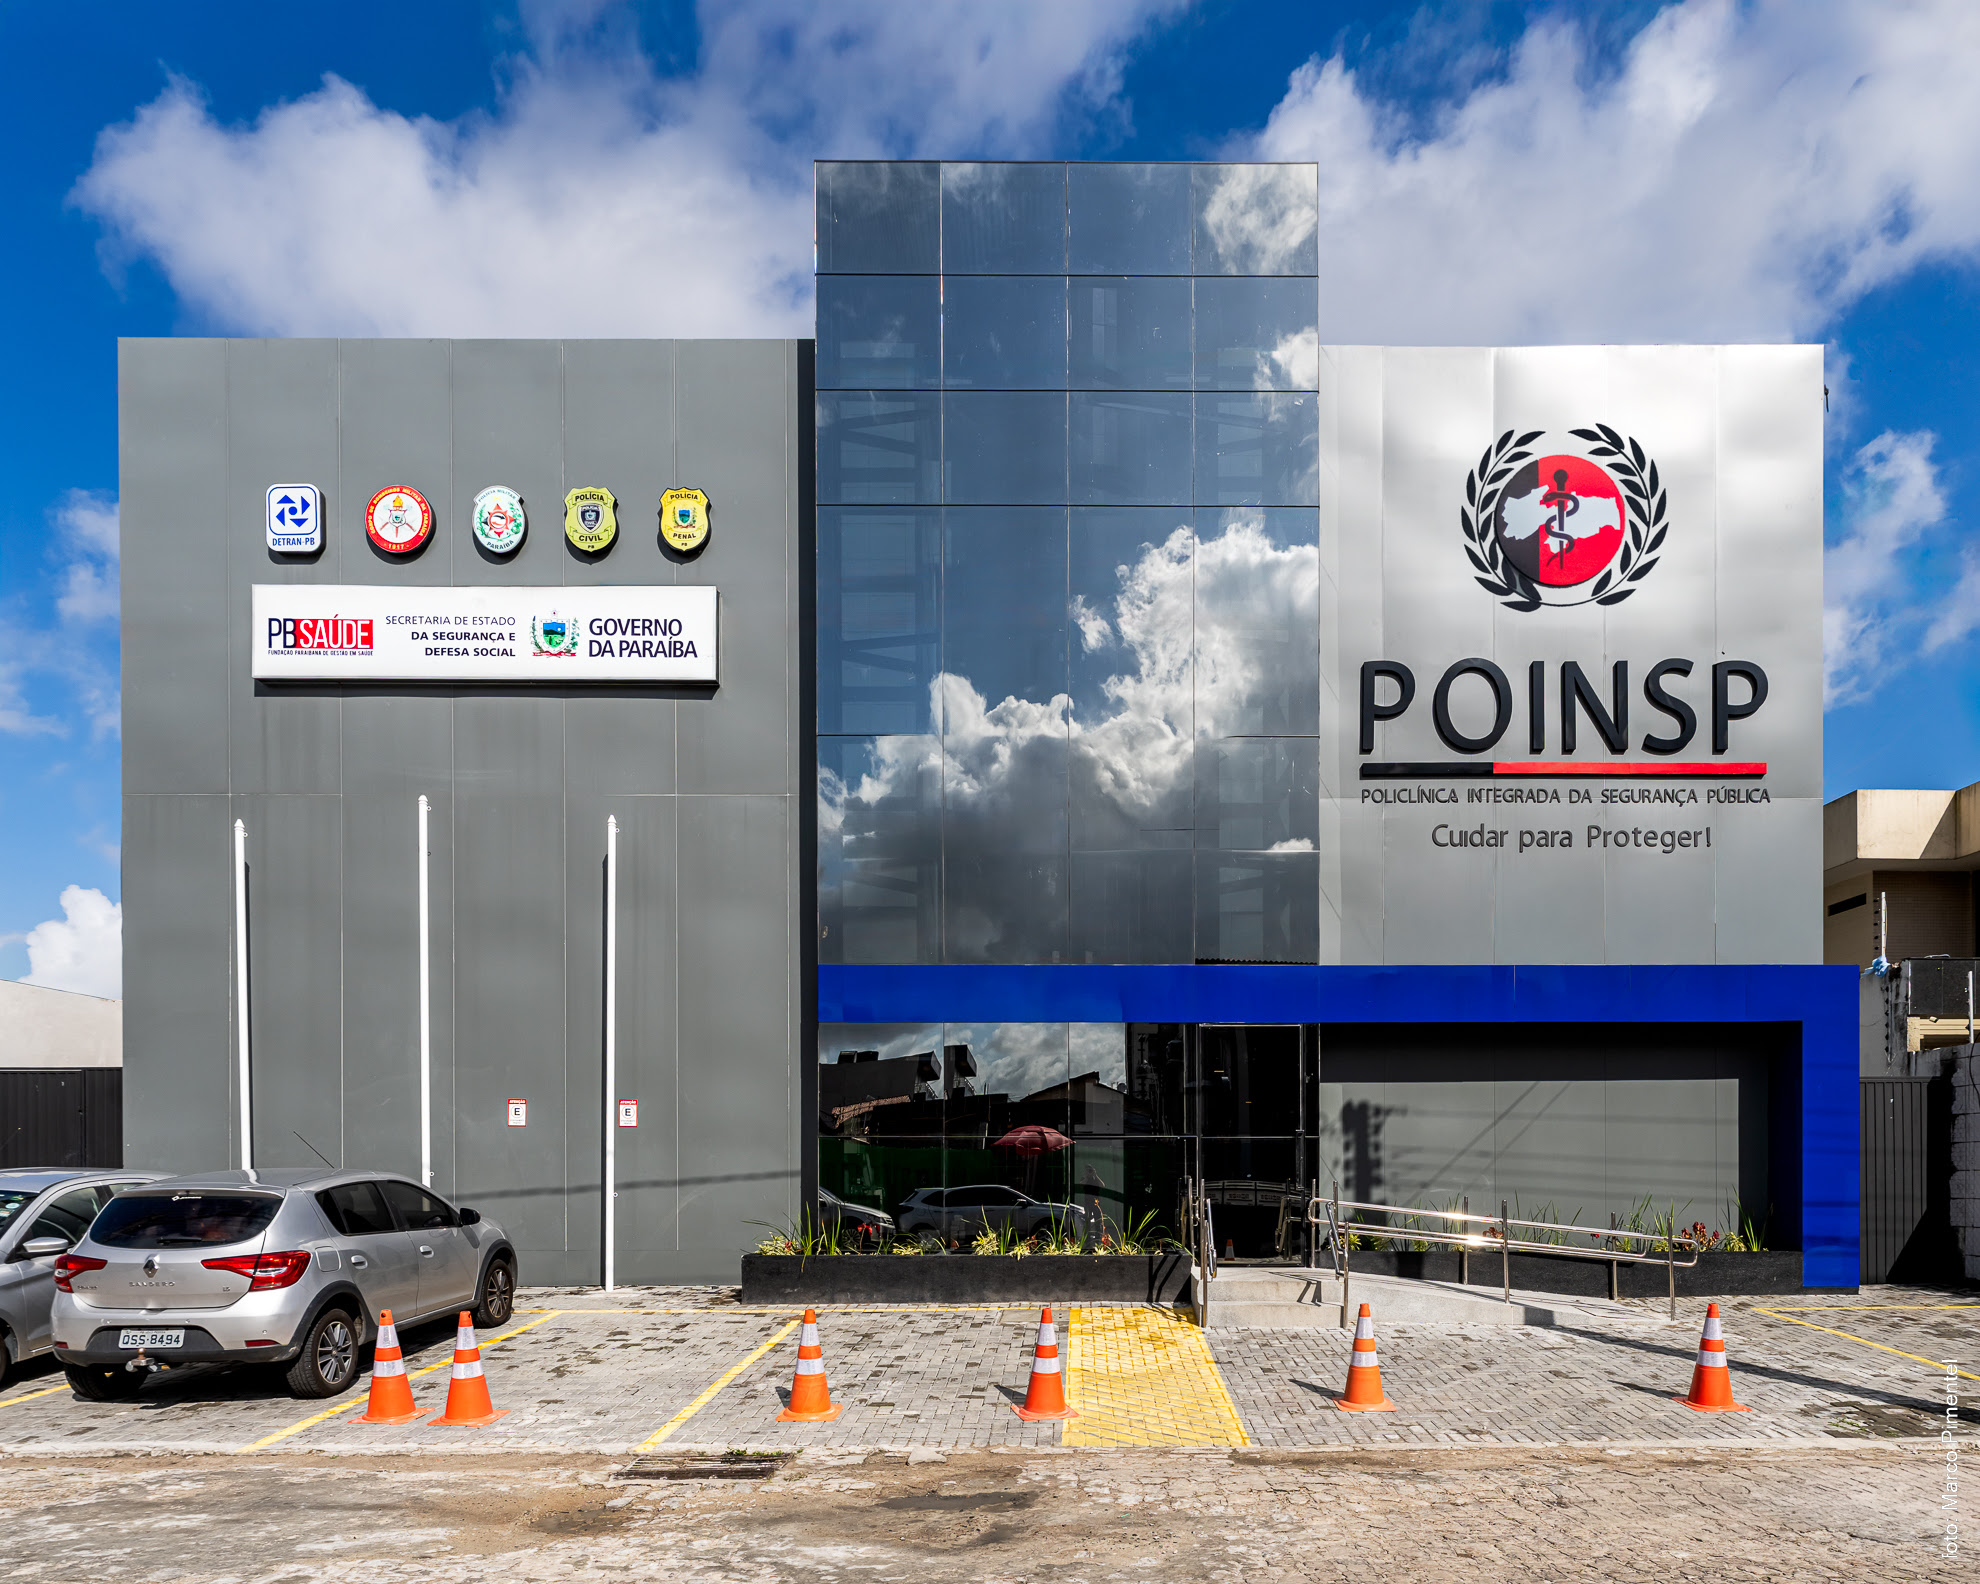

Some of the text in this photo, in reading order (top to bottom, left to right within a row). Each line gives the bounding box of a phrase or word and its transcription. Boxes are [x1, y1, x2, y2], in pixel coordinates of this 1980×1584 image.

[574, 491, 605, 502] POLÍCIA
[272, 537, 315, 546] DETRAN-PB
[578, 534, 603, 542] CIVIL
[672, 532, 697, 540] PENAL
[385, 615, 516, 626] SECRETARIA DE ESTADO
[588, 618, 683, 637] GOVERNO
[411, 631, 516, 643] DA SEGURANÇA E
[424, 647, 516, 657] DEFESA SOCIAL
[588, 636, 698, 658] DA PARAÍBA
[1359, 657, 1769, 755] POINSP
[1361, 784, 1771, 807] POLICLÍNICA INTEGRADA DA SEGURANÇA PÚBLICA
[1431, 823, 1712, 854] Cuidar para Proteger!
[514, 1107, 521, 1116] E
[625, 1108, 631, 1117] E
